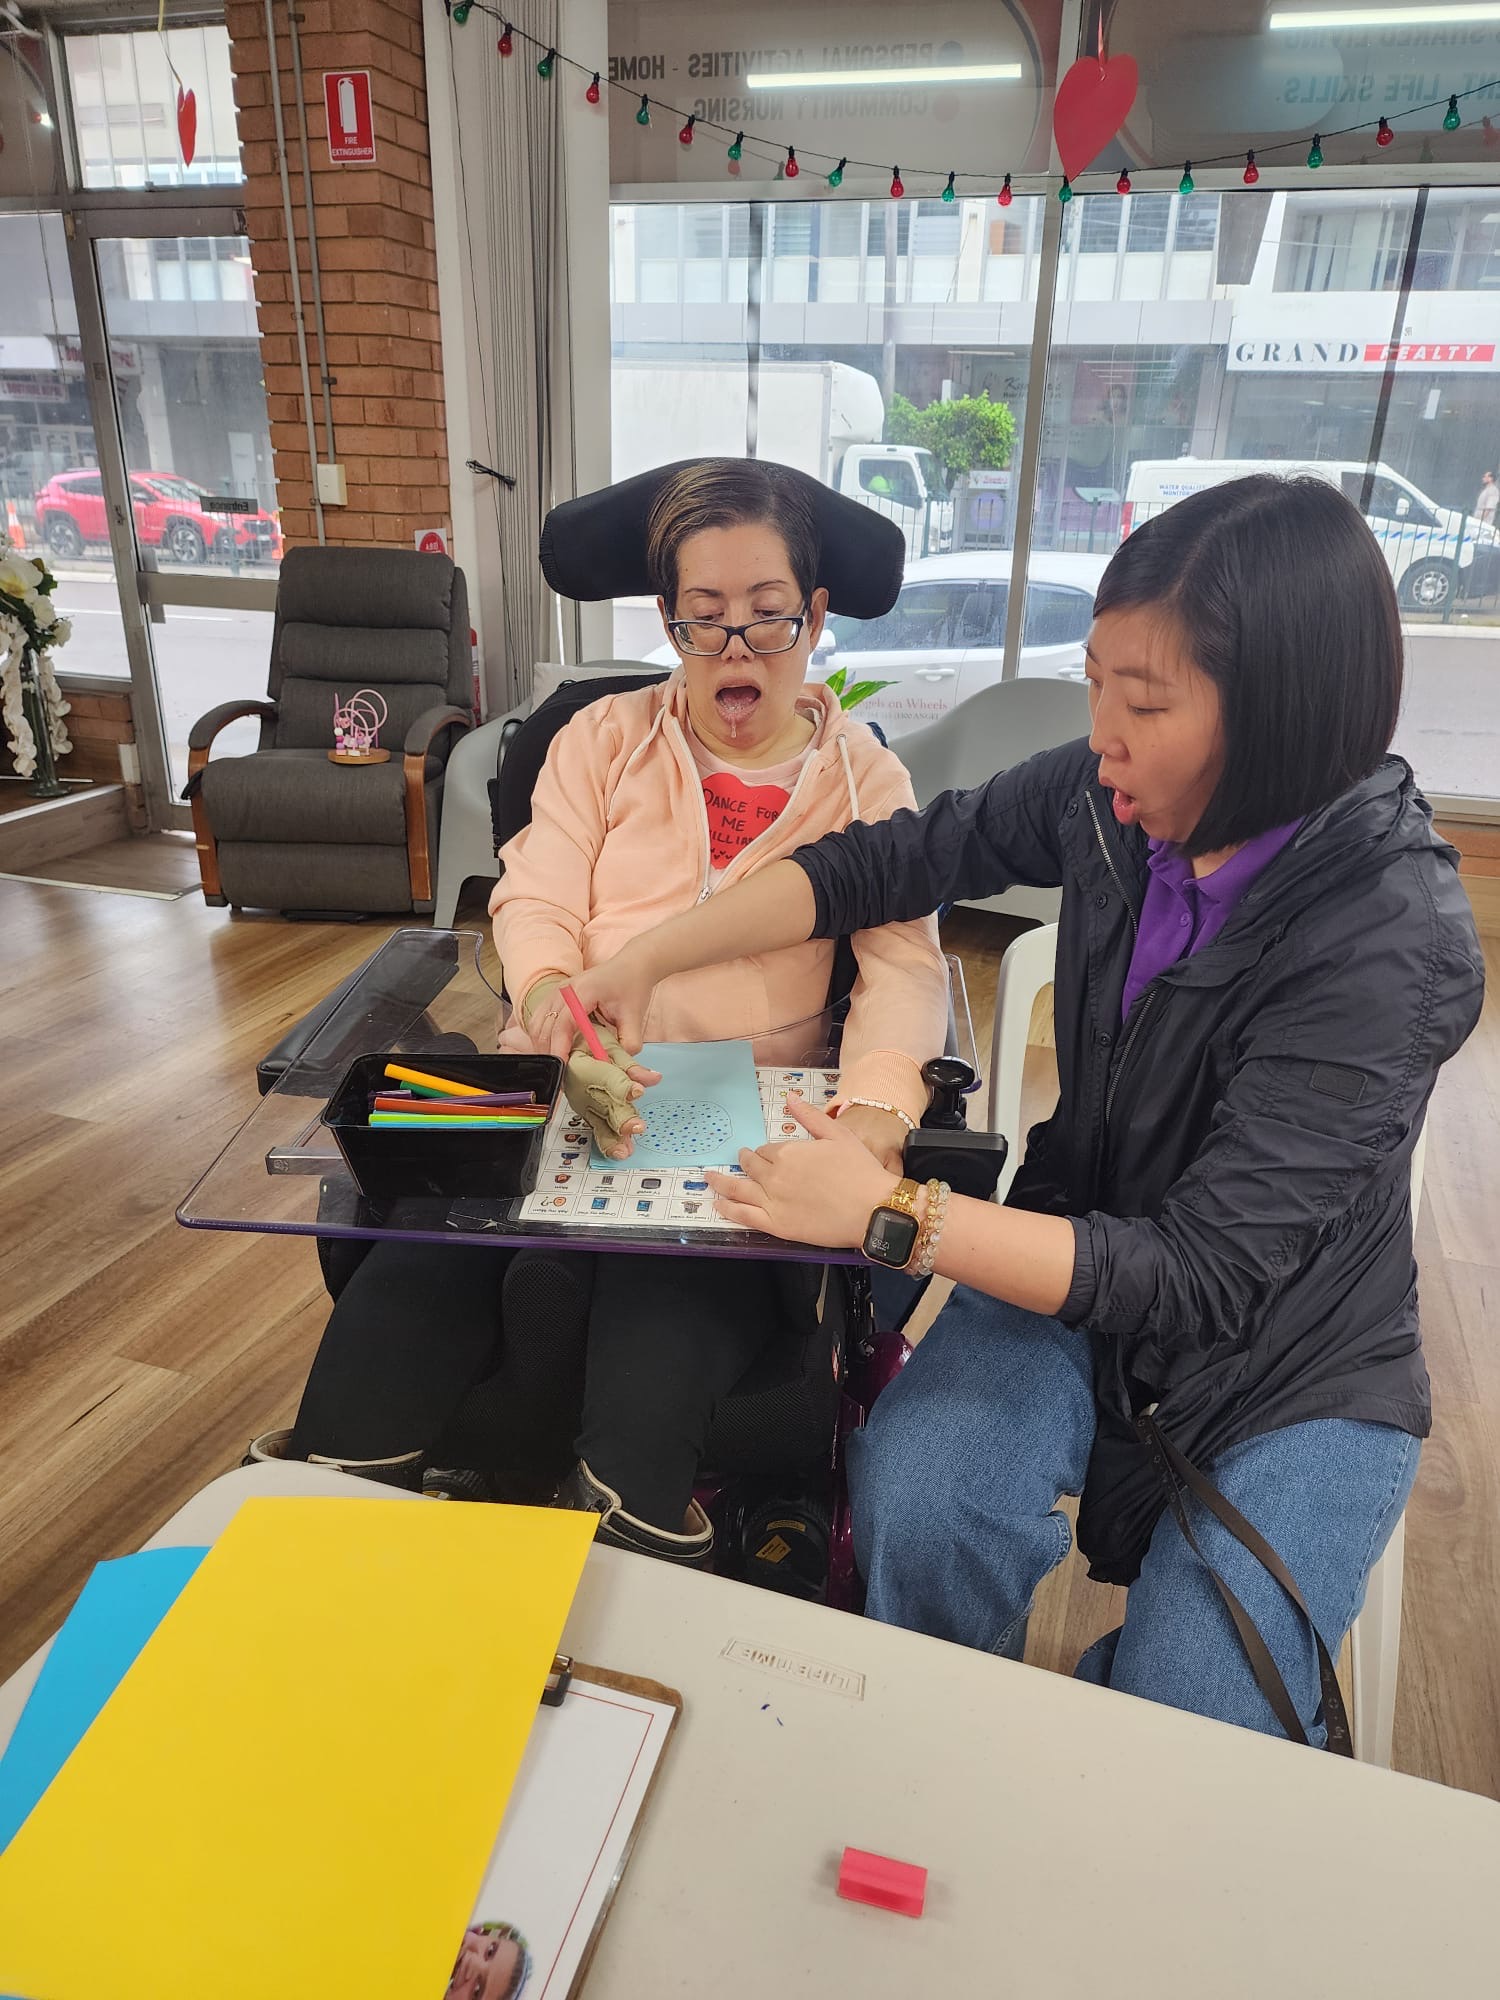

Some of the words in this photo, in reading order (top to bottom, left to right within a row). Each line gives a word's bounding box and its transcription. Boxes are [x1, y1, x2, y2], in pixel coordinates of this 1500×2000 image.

[344, 136, 358, 145] FIRE
[331, 147, 373, 156] EXTINGUISHER
[1235, 342, 1359, 363] GRAND
[888, 701, 903, 709] on
[906, 697, 949, 711] Wheels
[702, 788, 748, 813] DANCE
[756, 807, 780, 821] FOR
[721, 816, 746, 832] ME
